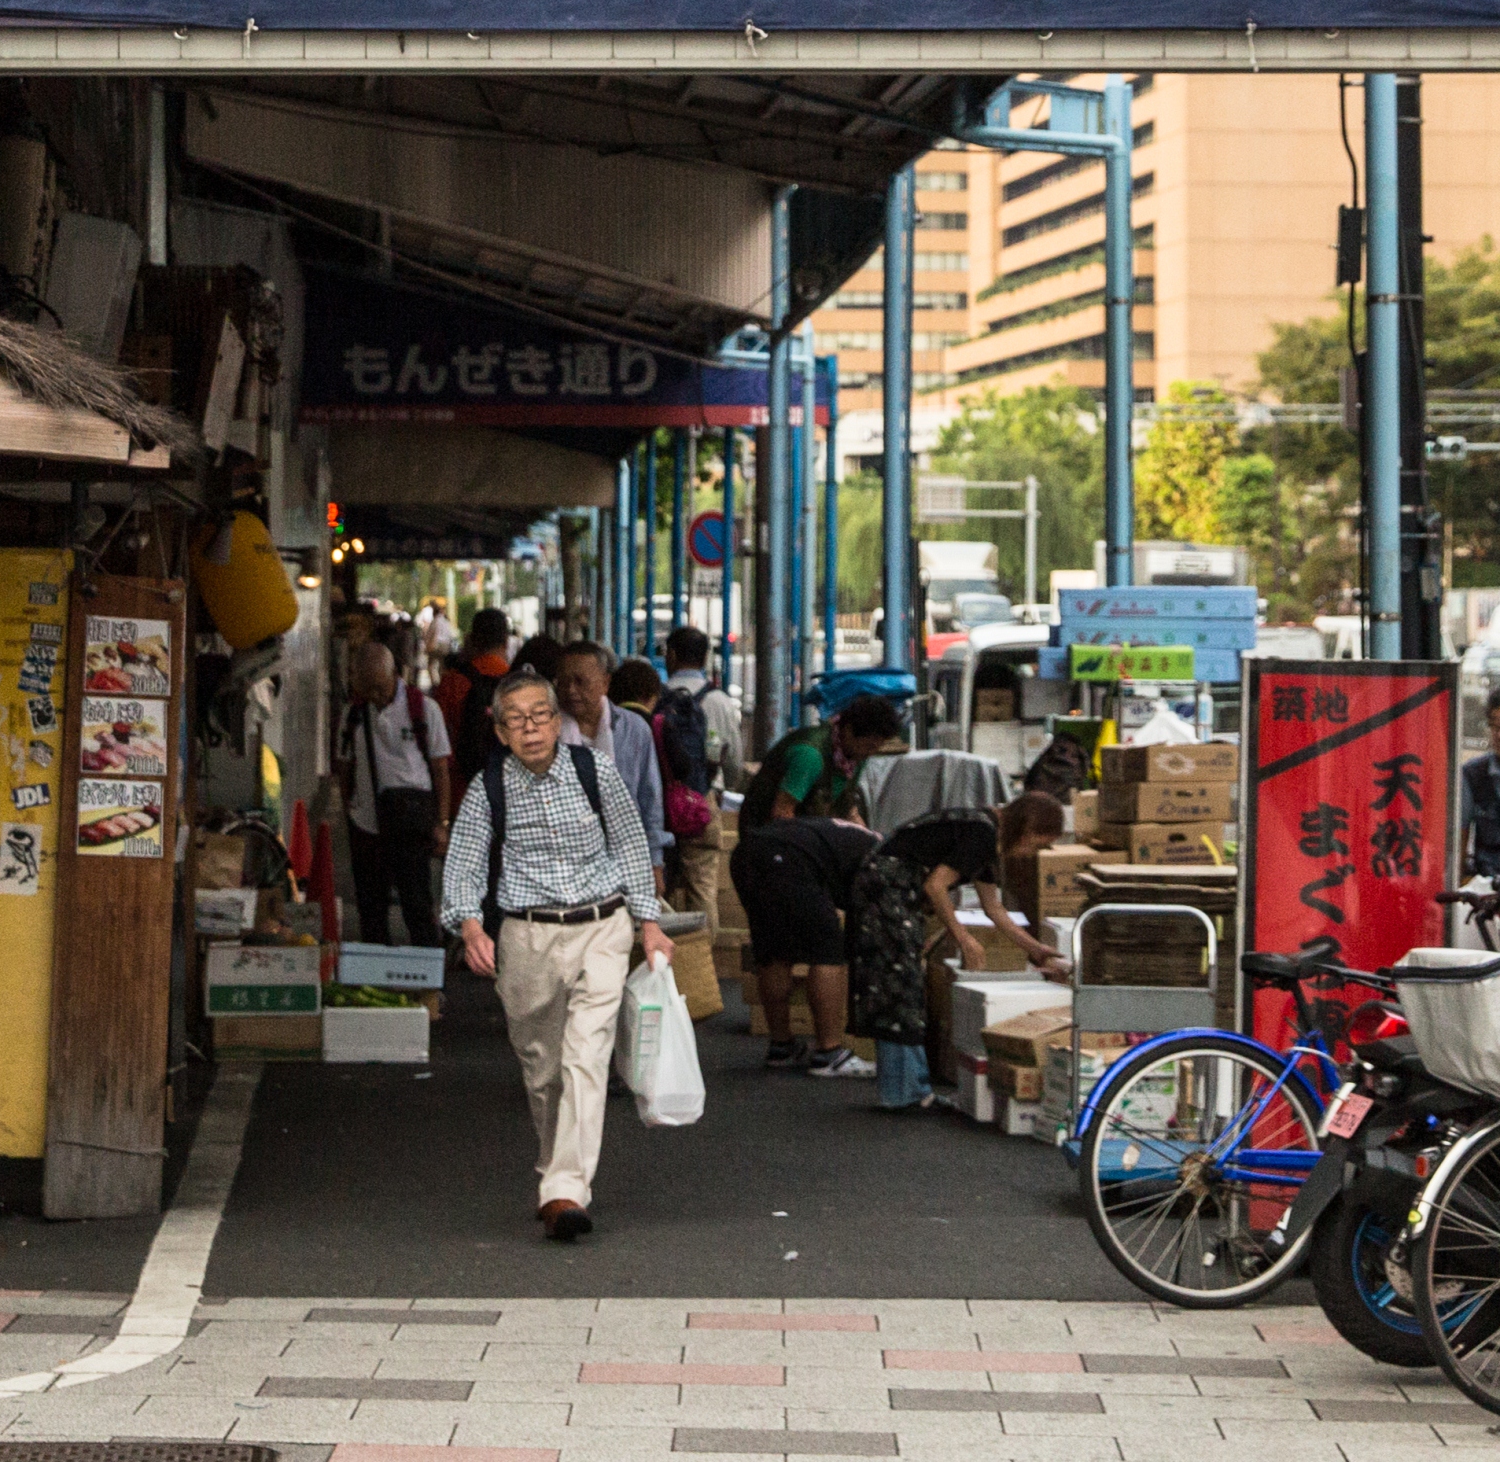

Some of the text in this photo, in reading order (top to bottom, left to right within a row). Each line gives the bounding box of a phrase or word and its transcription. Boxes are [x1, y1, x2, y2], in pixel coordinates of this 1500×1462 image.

[343, 342, 658, 396] もんぜき通り
[1272, 685, 1350, 725] 築地
[1369, 753, 1424, 879] 天然
